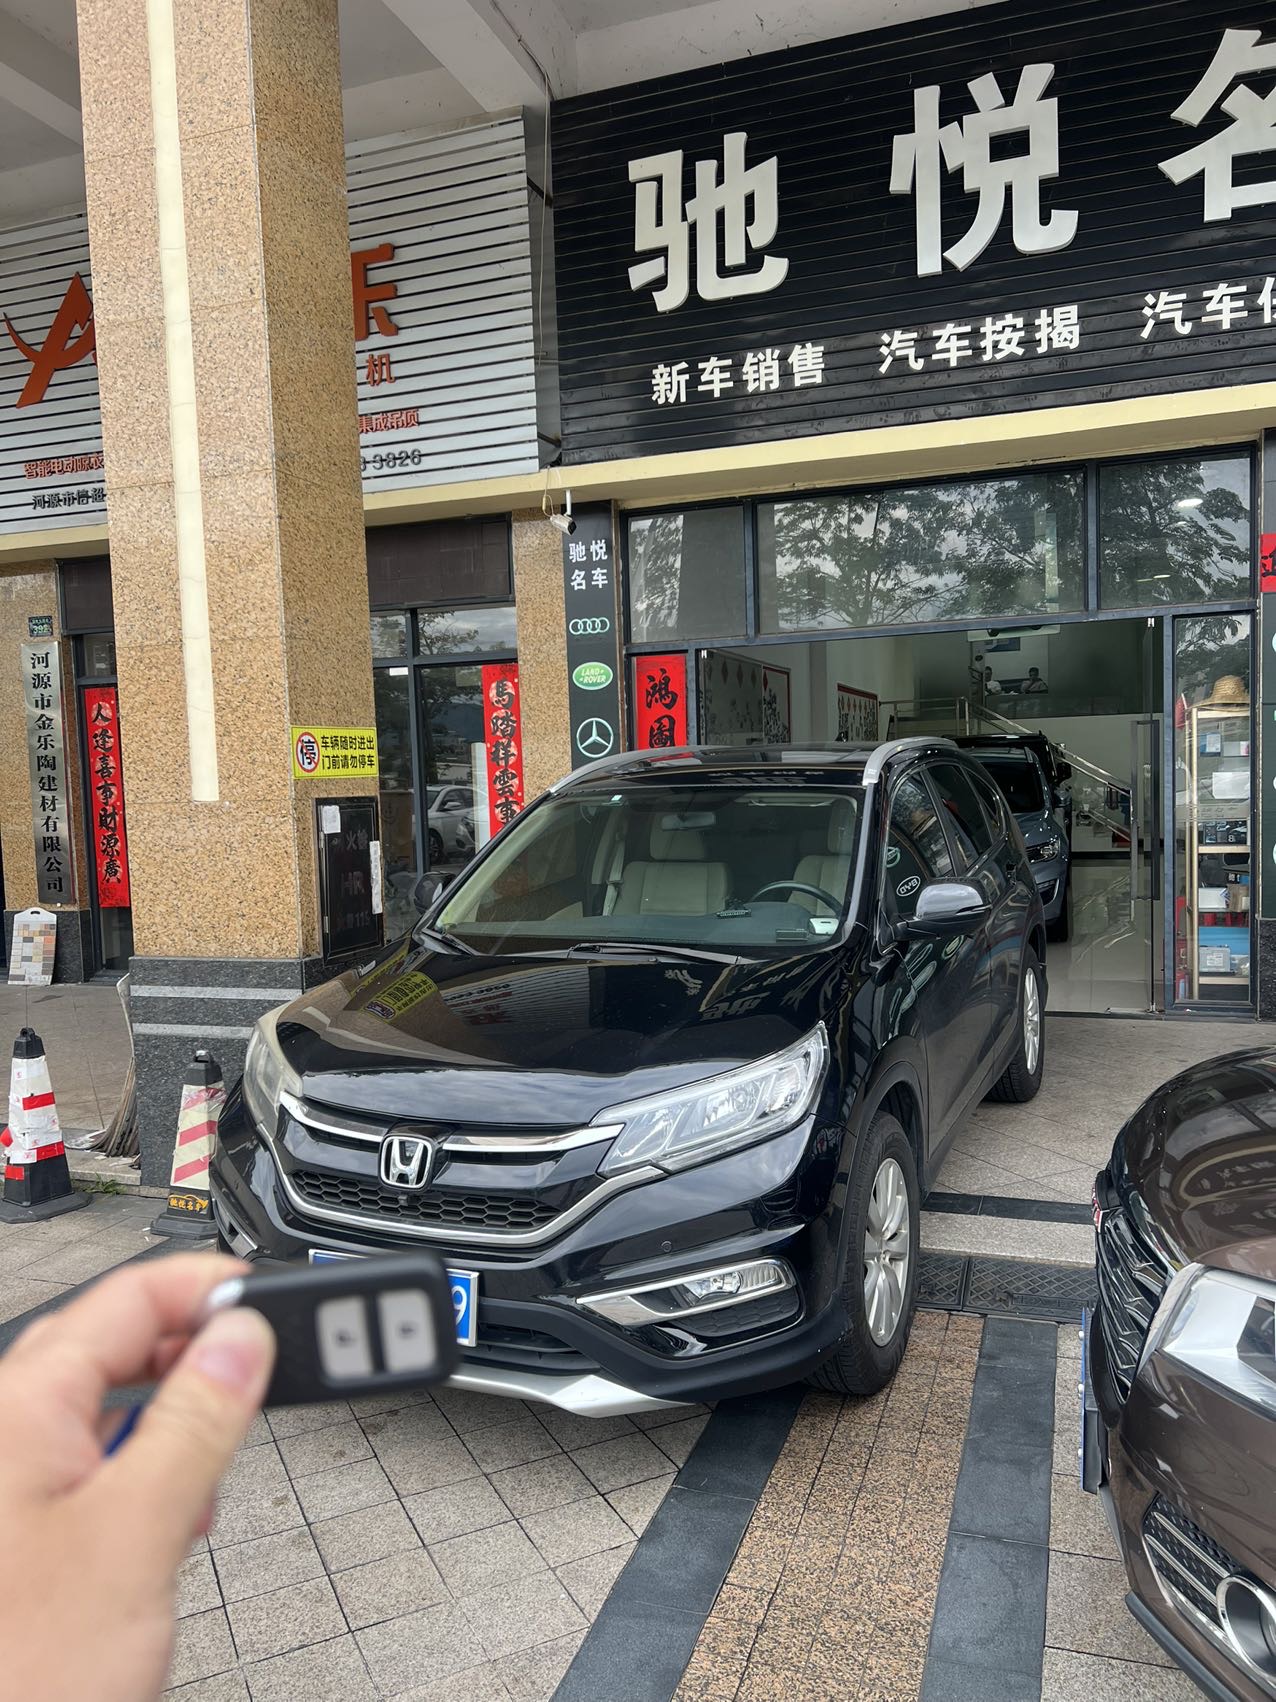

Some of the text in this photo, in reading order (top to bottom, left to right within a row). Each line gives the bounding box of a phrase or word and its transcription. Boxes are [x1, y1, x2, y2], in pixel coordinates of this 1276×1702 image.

[651, 342, 825, 405] 新车销售
[879, 304, 1080, 374] 汽车按揭
[366, 353, 396, 387] 机
[569, 539, 608, 563] 驰悦
[570, 567, 608, 591] 名车
[581, 668, 601, 677] LAND
[583, 675, 607, 684] ROVER
[321, 734, 375, 751] 车辆随时进出
[30, 652, 64, 893] 河源市金乐陶建材有限公司
[321, 754, 375, 770] 门前请勿停车
